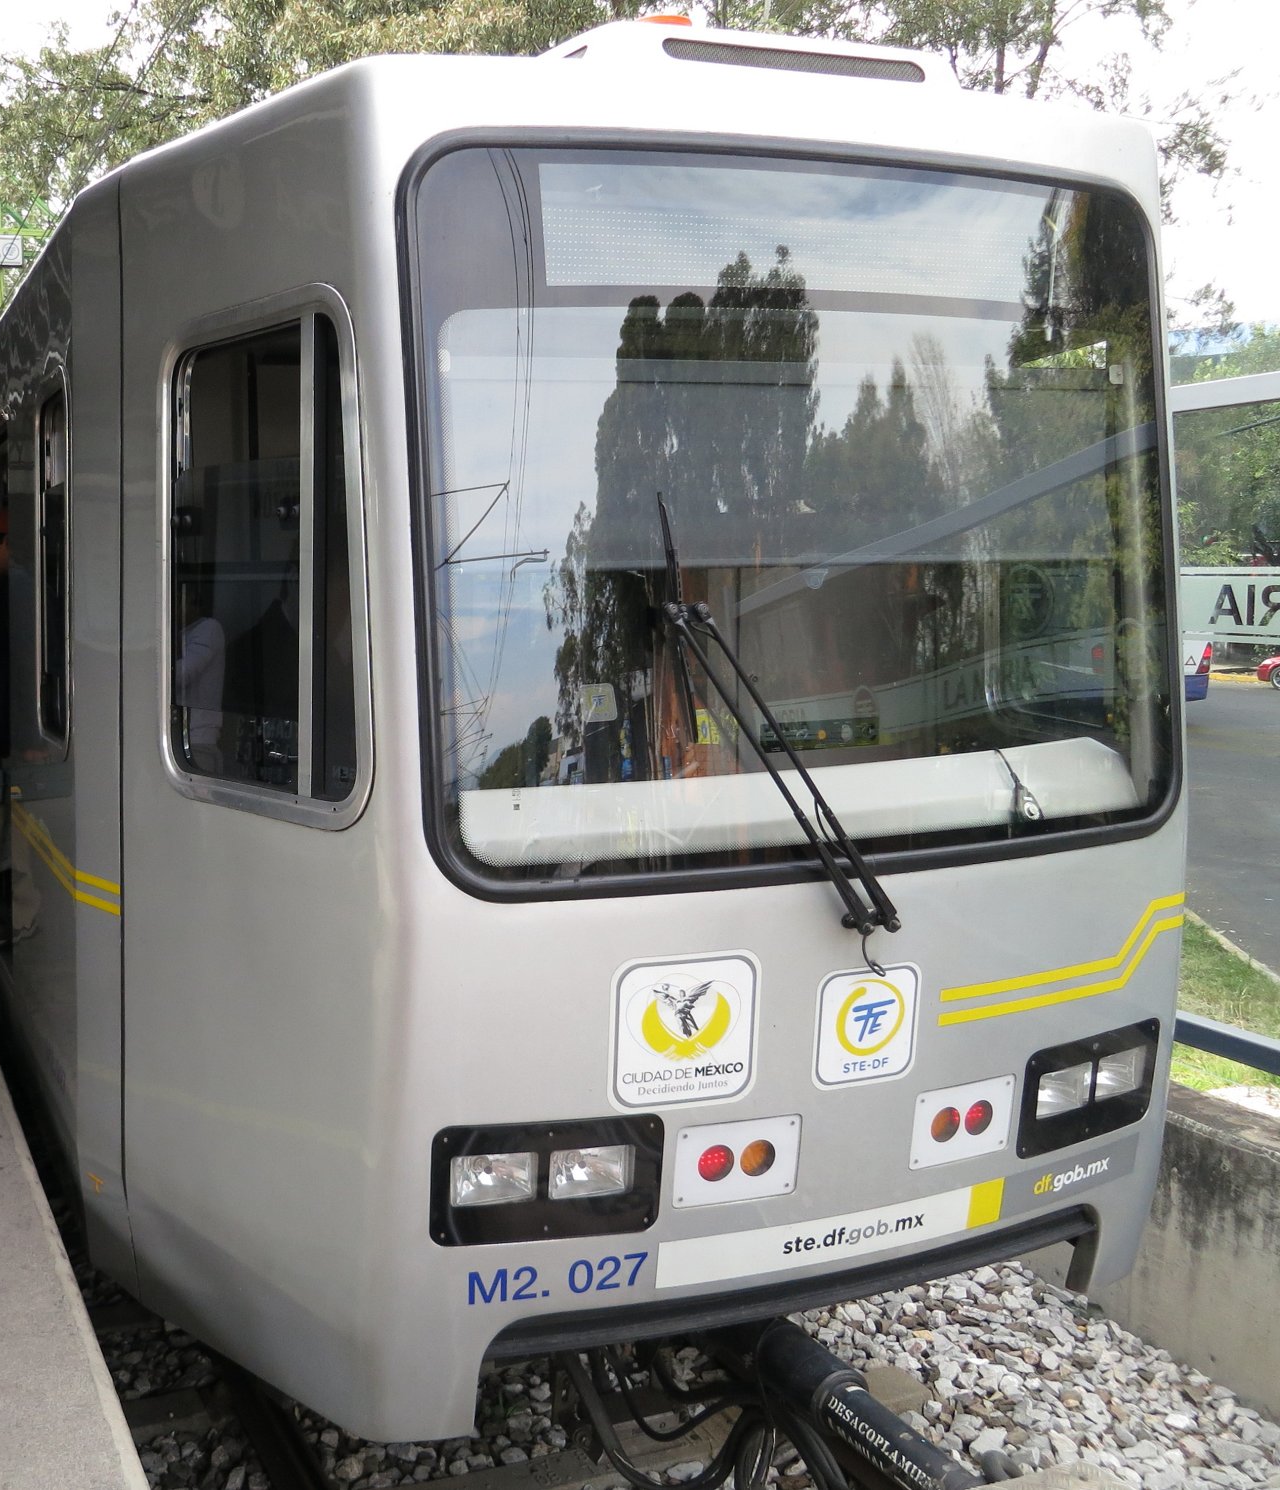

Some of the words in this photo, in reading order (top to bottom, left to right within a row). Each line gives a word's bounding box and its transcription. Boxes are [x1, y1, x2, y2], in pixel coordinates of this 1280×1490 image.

[622, 1069, 672, 1085] CIUDAD
[674, 1067, 692, 1081] DE
[694, 1062, 744, 1077] MÉXICO
[842, 1057, 889, 1074] STE-DF
[637, 1081, 695, 1097] Decidiendo
[696, 1078, 729, 1092] Juntos
[1033, 1157, 1110, 1196] df.gob.mx
[782, 1212, 925, 1256] ste.df.gob.mx
[468, 1266, 550, 1306] M2.
[568, 1252, 649, 1294] 027
